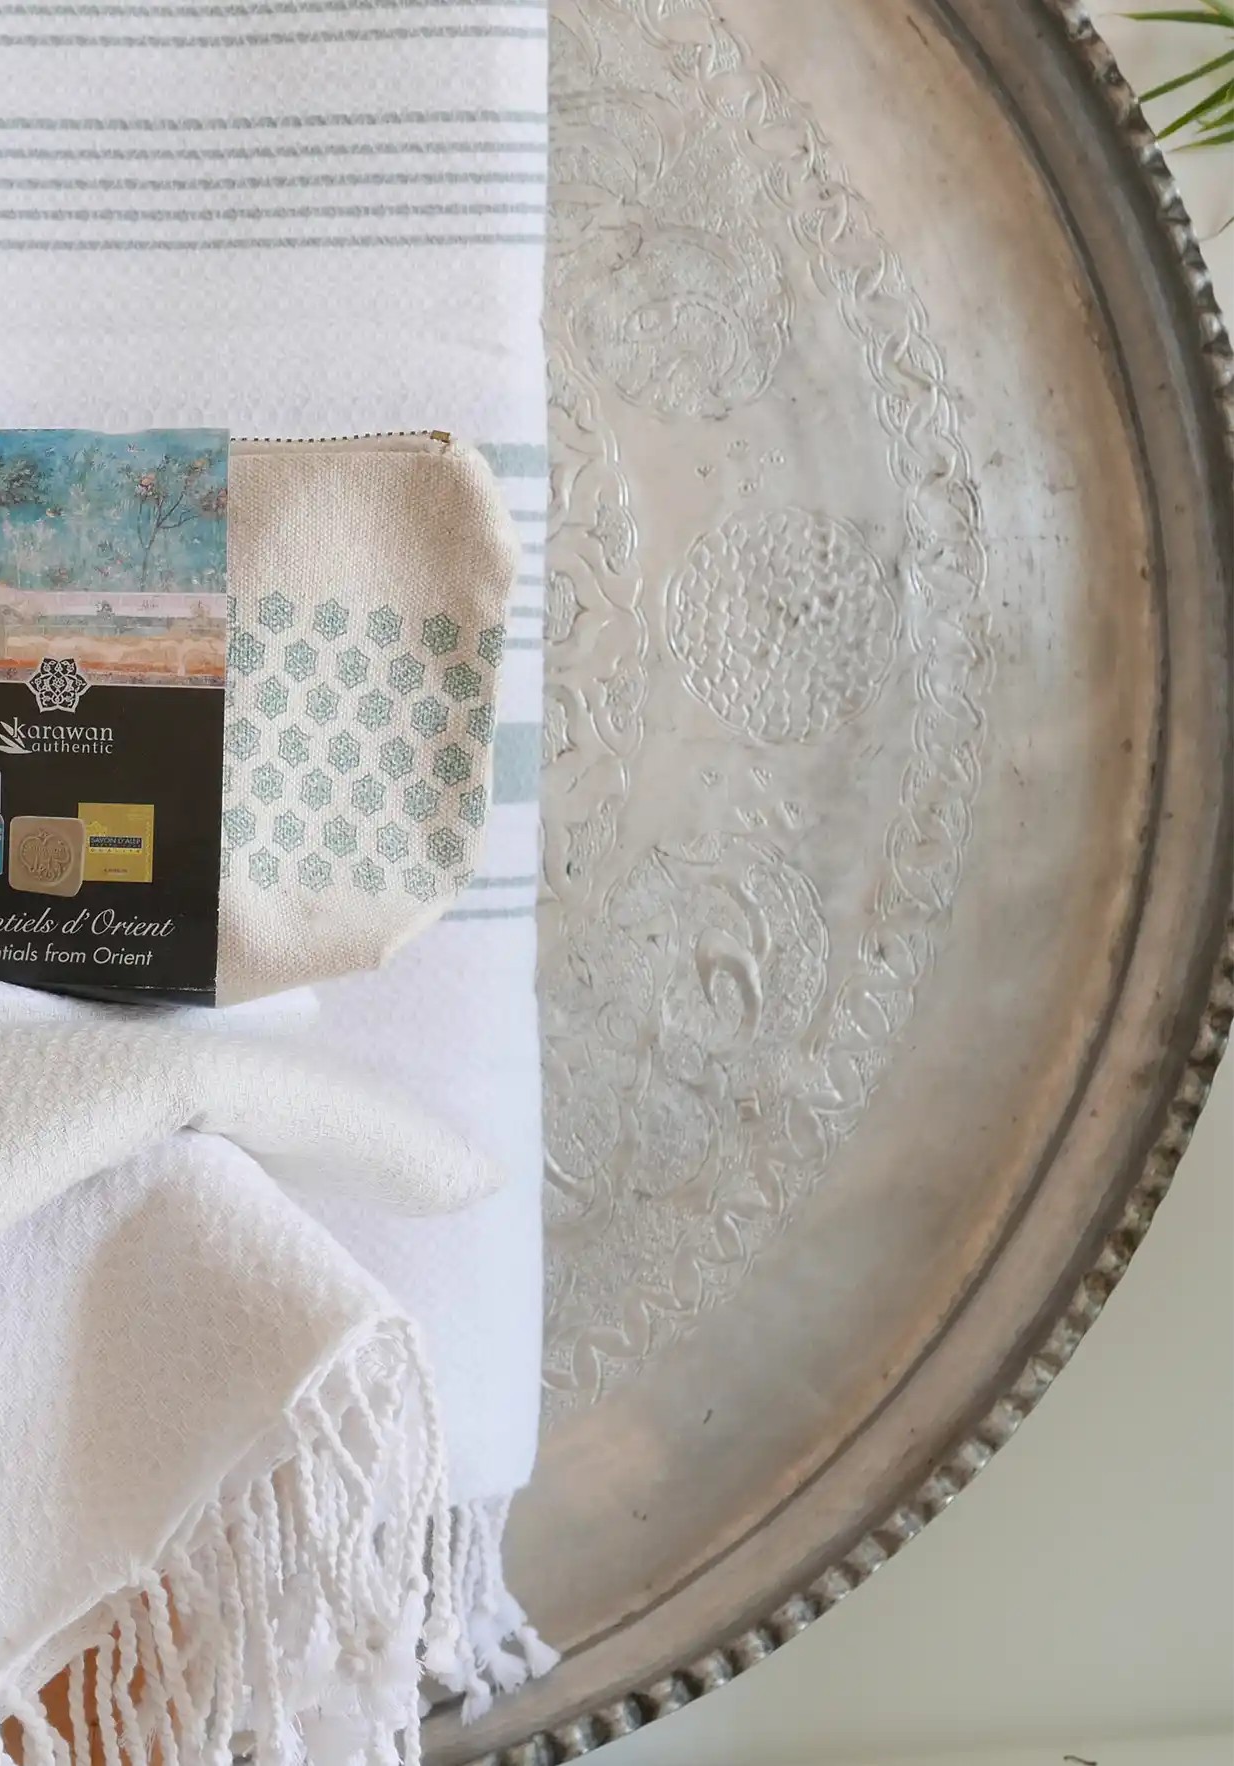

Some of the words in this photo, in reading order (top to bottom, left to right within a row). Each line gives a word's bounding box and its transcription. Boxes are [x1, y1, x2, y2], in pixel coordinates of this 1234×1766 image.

[13, 717, 115, 741] karawan
[31, 739, 114, 754] authentic
[44, 942, 87, 964] from
[93, 947, 153, 966] Orient
